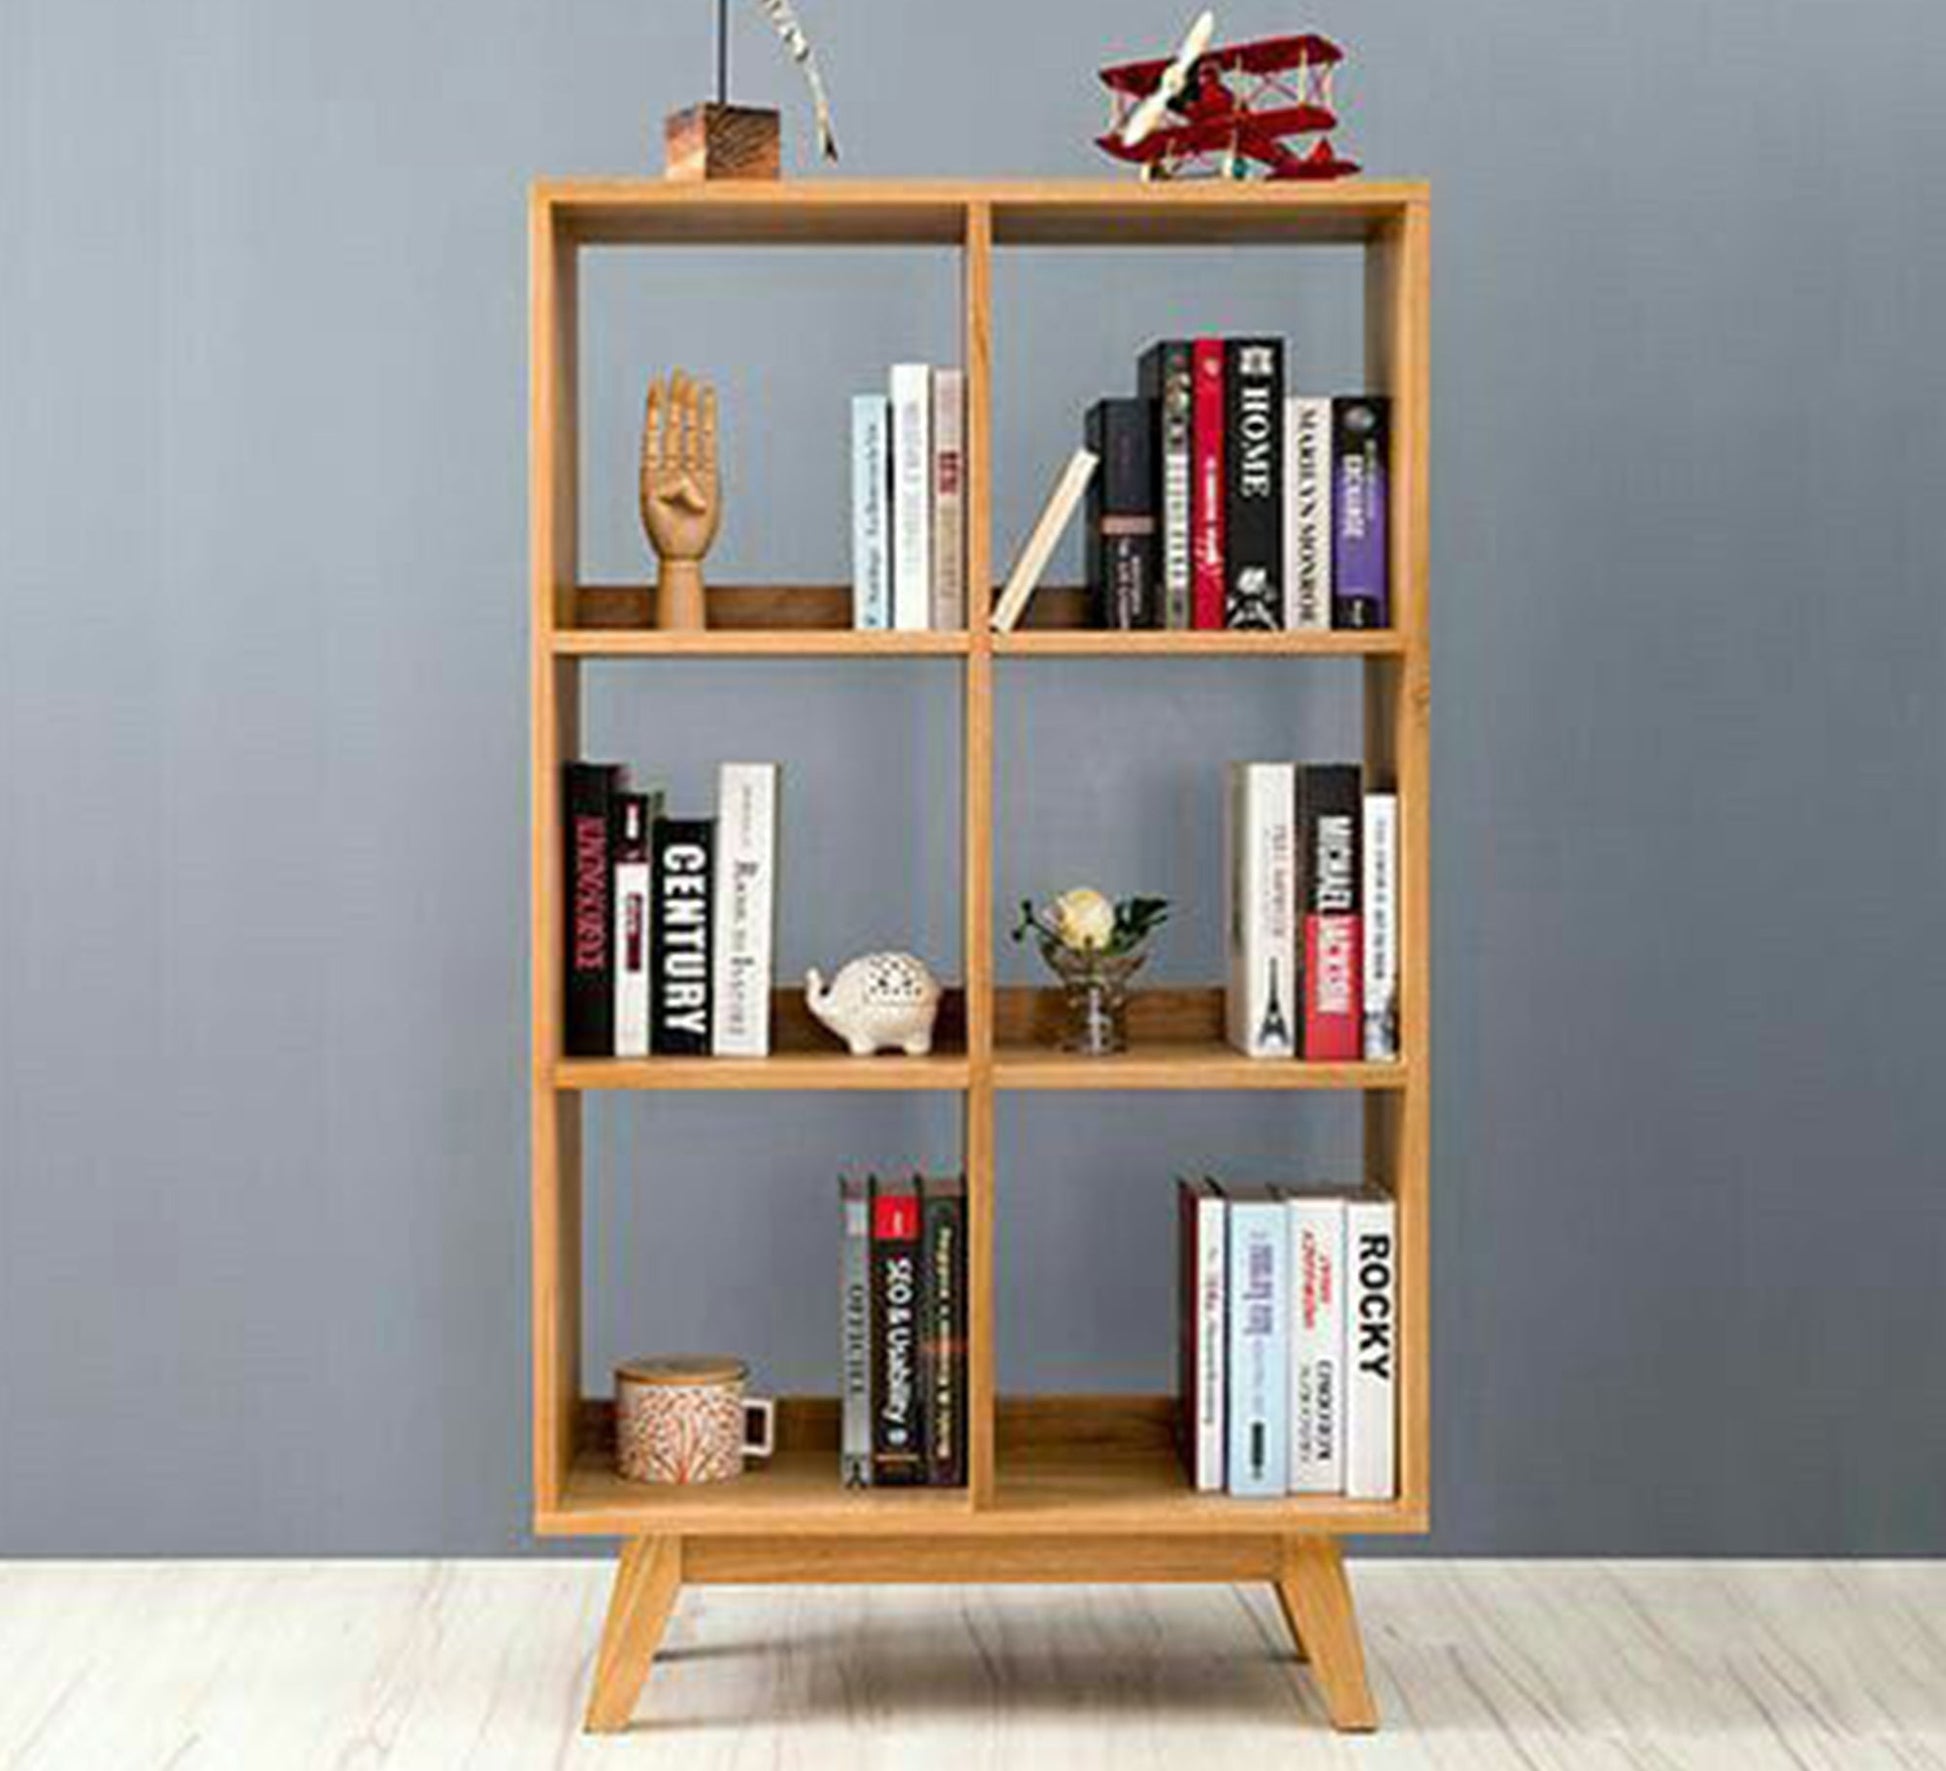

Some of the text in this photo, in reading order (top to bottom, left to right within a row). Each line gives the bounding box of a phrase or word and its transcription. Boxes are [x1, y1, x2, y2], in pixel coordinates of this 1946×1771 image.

[1240, 387, 1271, 498] HOME
[1299, 408, 1318, 518] MARILYN
[663, 845, 707, 1034] CENTURY
[1316, 815, 1353, 1015] MICHAEL JACKSON
[885, 1257, 914, 1306] SEO
[887, 1308, 912, 1325] &
[1359, 1234, 1391, 1380] ROCKY
[881, 1326, 912, 1424] Usability
